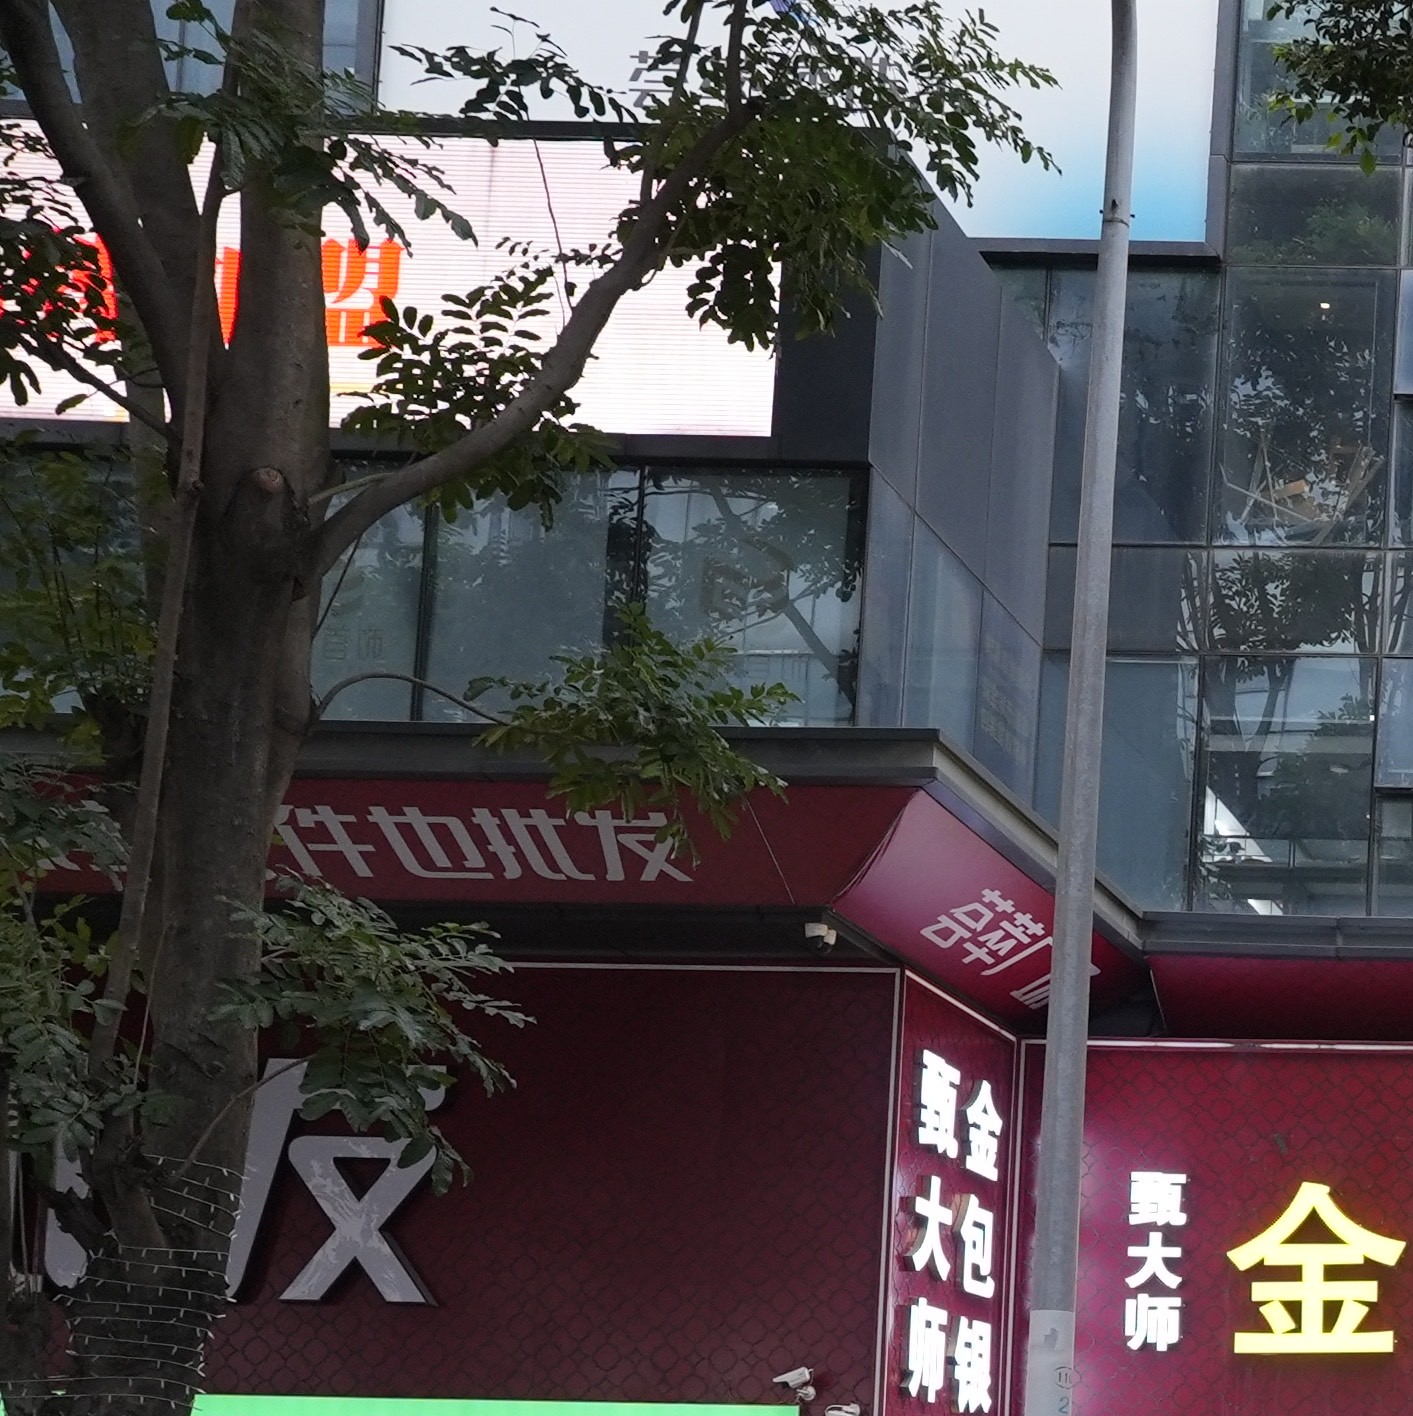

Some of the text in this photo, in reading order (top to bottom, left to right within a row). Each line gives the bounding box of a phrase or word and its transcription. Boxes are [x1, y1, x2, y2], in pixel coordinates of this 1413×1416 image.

[954, 1080, 1003, 1414] 金包银
[1125, 1171, 1187, 1352] 甄大师
